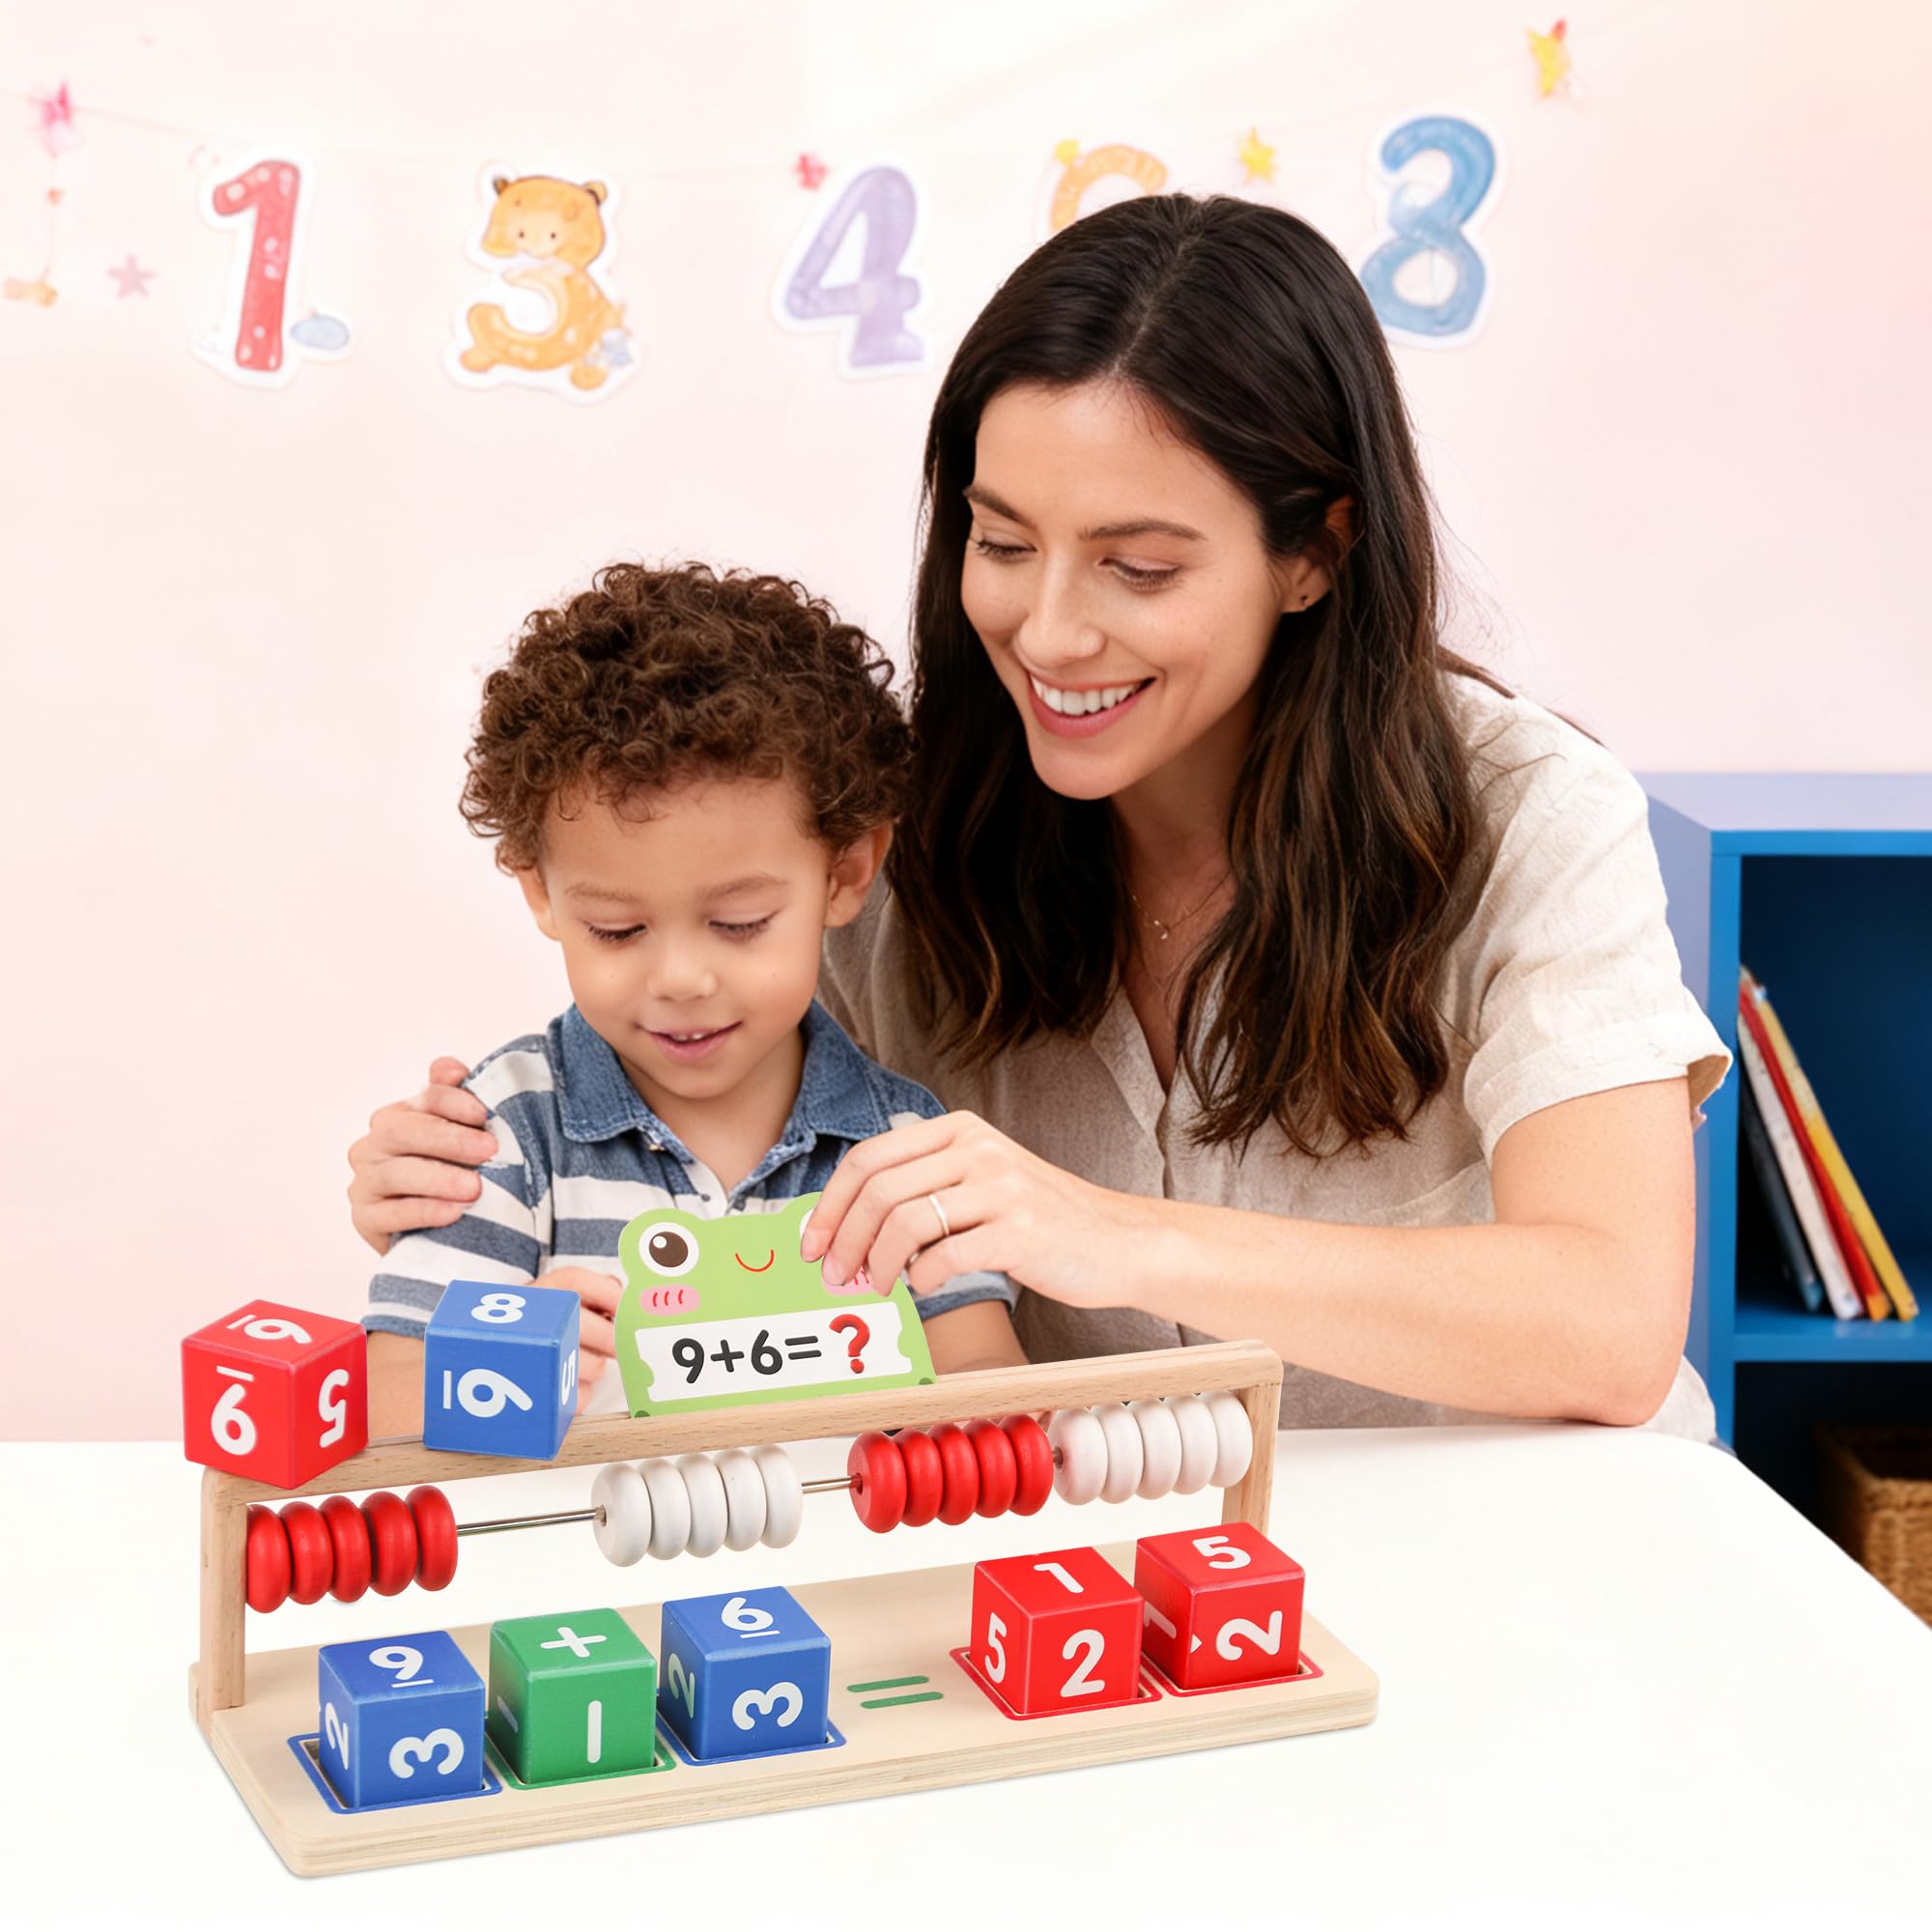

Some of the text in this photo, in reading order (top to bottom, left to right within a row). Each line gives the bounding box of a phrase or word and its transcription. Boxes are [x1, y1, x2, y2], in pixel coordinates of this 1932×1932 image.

[1360, 115, 1496, 336] 8
[213, 158, 301, 372] 1
[785, 166, 924, 368] 4
[470, 1293, 526, 1324] 8
[671, 1313, 871, 1385] 9+6=?
[1034, 1562, 1085, 1594] 1
[1193, 1535, 1252, 1570] 5
[984, 1612, 1008, 1684] 5
[1060, 1629, 1106, 1698] 2
[1216, 1610, 1284, 1661] 2
[731, 1681, 804, 1731] 3
[388, 1727, 465, 1779] 3
